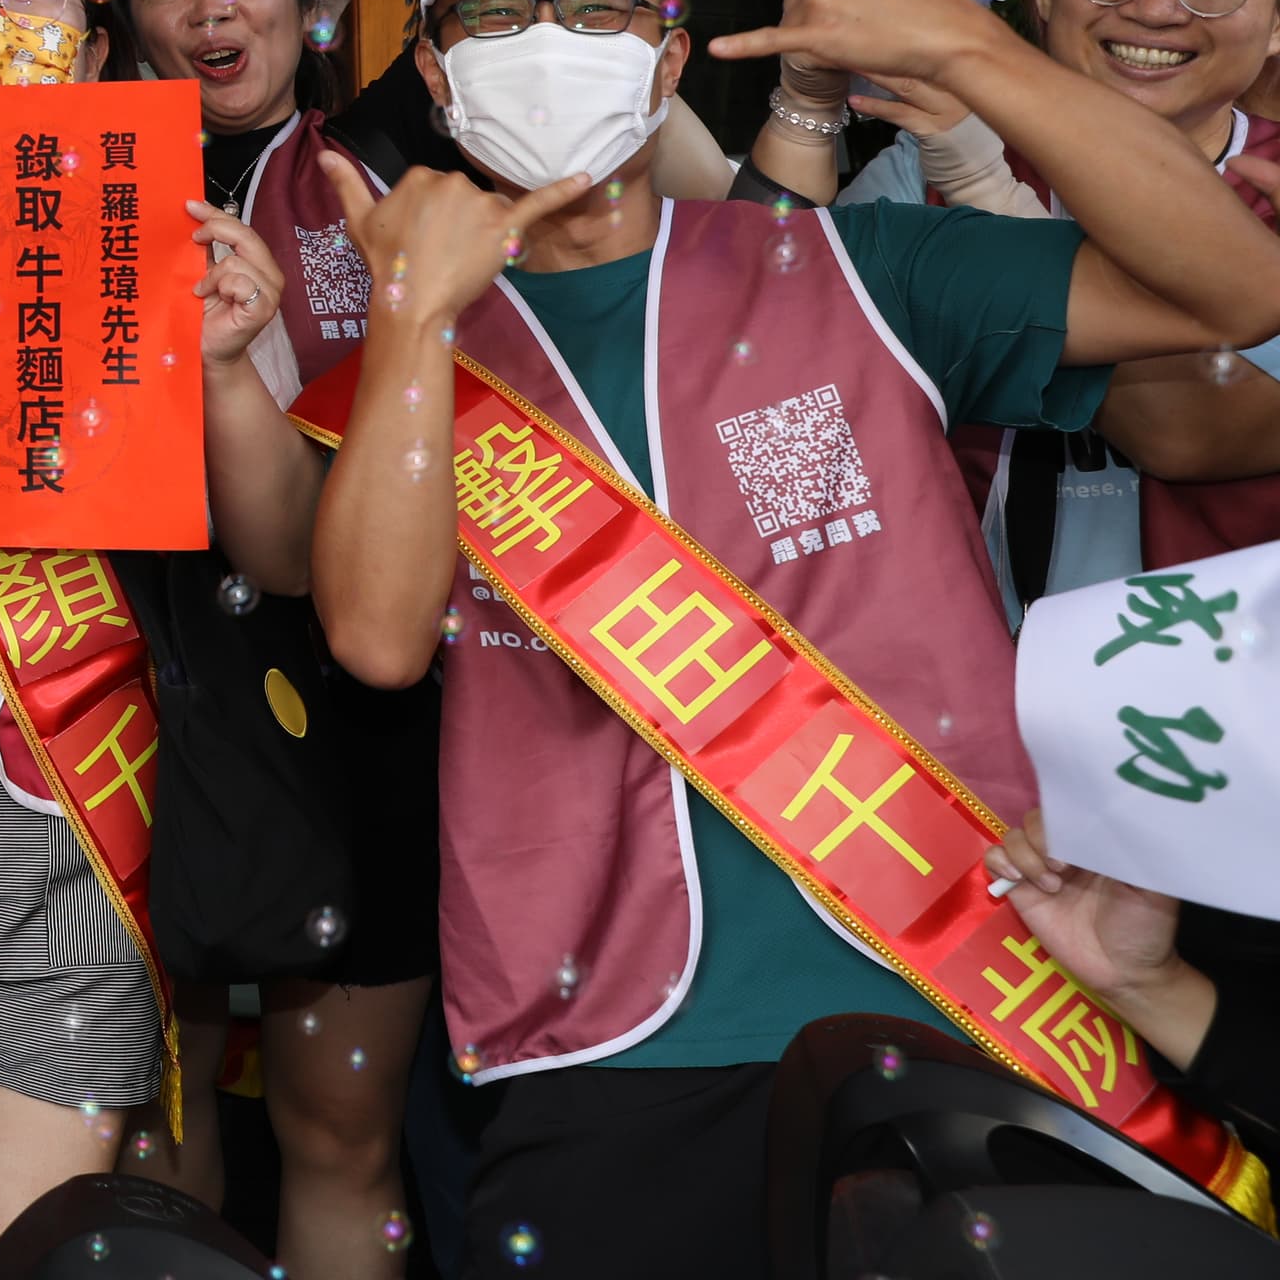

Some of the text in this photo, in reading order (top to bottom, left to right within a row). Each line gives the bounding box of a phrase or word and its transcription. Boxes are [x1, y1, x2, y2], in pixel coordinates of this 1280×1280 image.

[14, 133, 65, 495] 錄取 牛肉麵店長
[99, 131, 141, 386] 賀 羅廷瑋先生
[320, 319, 368, 340] 罷免
[770, 508, 882, 565] 罷免問我
